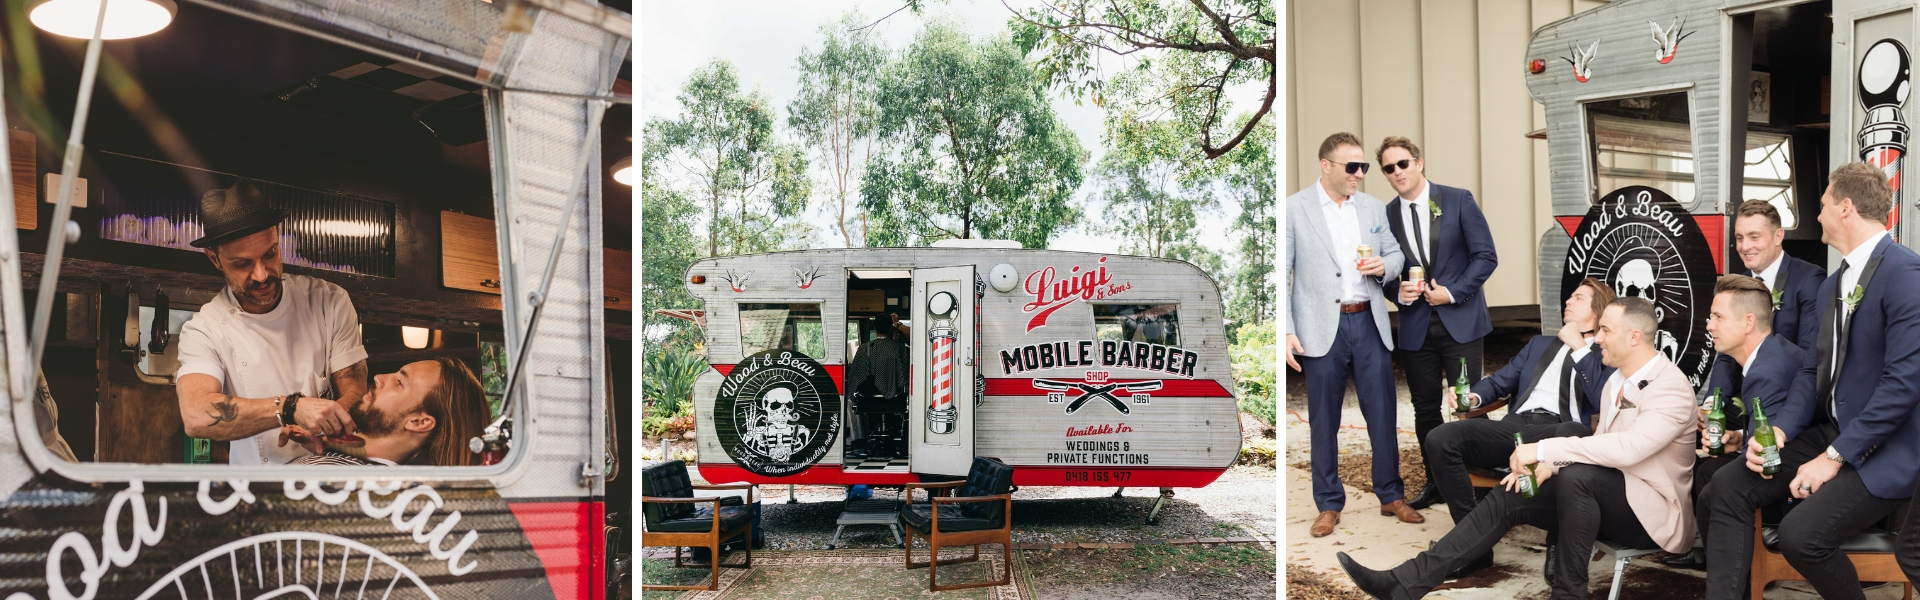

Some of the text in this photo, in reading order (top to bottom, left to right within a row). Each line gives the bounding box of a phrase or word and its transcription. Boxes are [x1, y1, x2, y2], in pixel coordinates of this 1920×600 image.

[1568, 190, 1685, 275] Wood & Beau
[1022, 255, 1113, 313] Luigi
[1096, 281, 1133, 300] & Sons
[999, 340, 1199, 380] MOBILE BARBER
[1697, 348, 1710, 374] met
[722, 351, 817, 397] Wood & Beau
[1085, 371, 1110, 382] SHOP
[1048, 393, 1151, 404] EST 1961
[1066, 423, 1133, 437] Available For
[1066, 441, 1130, 451] WEDDINGS &
[1047, 453, 1149, 465] PRIVATE FUNCTIONS
[764, 465, 786, 473] When
[1065, 471, 1132, 482] 0418 155 477
[283, 479, 478, 577] eau
